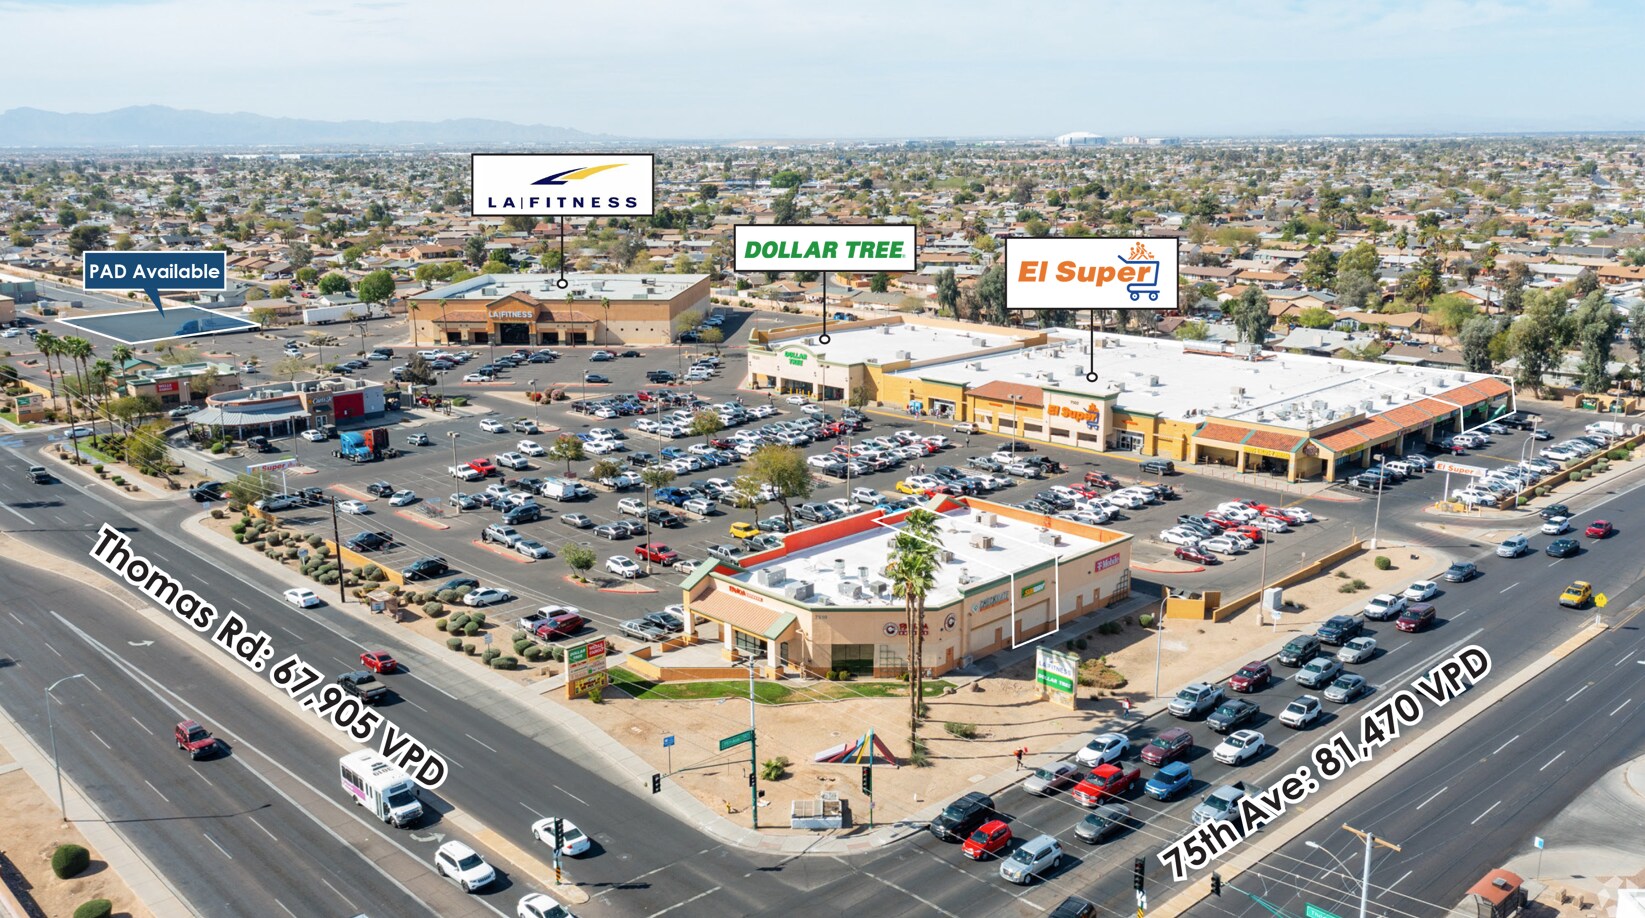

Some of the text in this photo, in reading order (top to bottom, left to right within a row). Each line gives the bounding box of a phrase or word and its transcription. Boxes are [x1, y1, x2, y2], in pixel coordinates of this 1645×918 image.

[784, 350, 808, 360] DOLLAR
[1047, 404, 1097, 423] El Super
[1436, 462, 1475, 475] El Super
